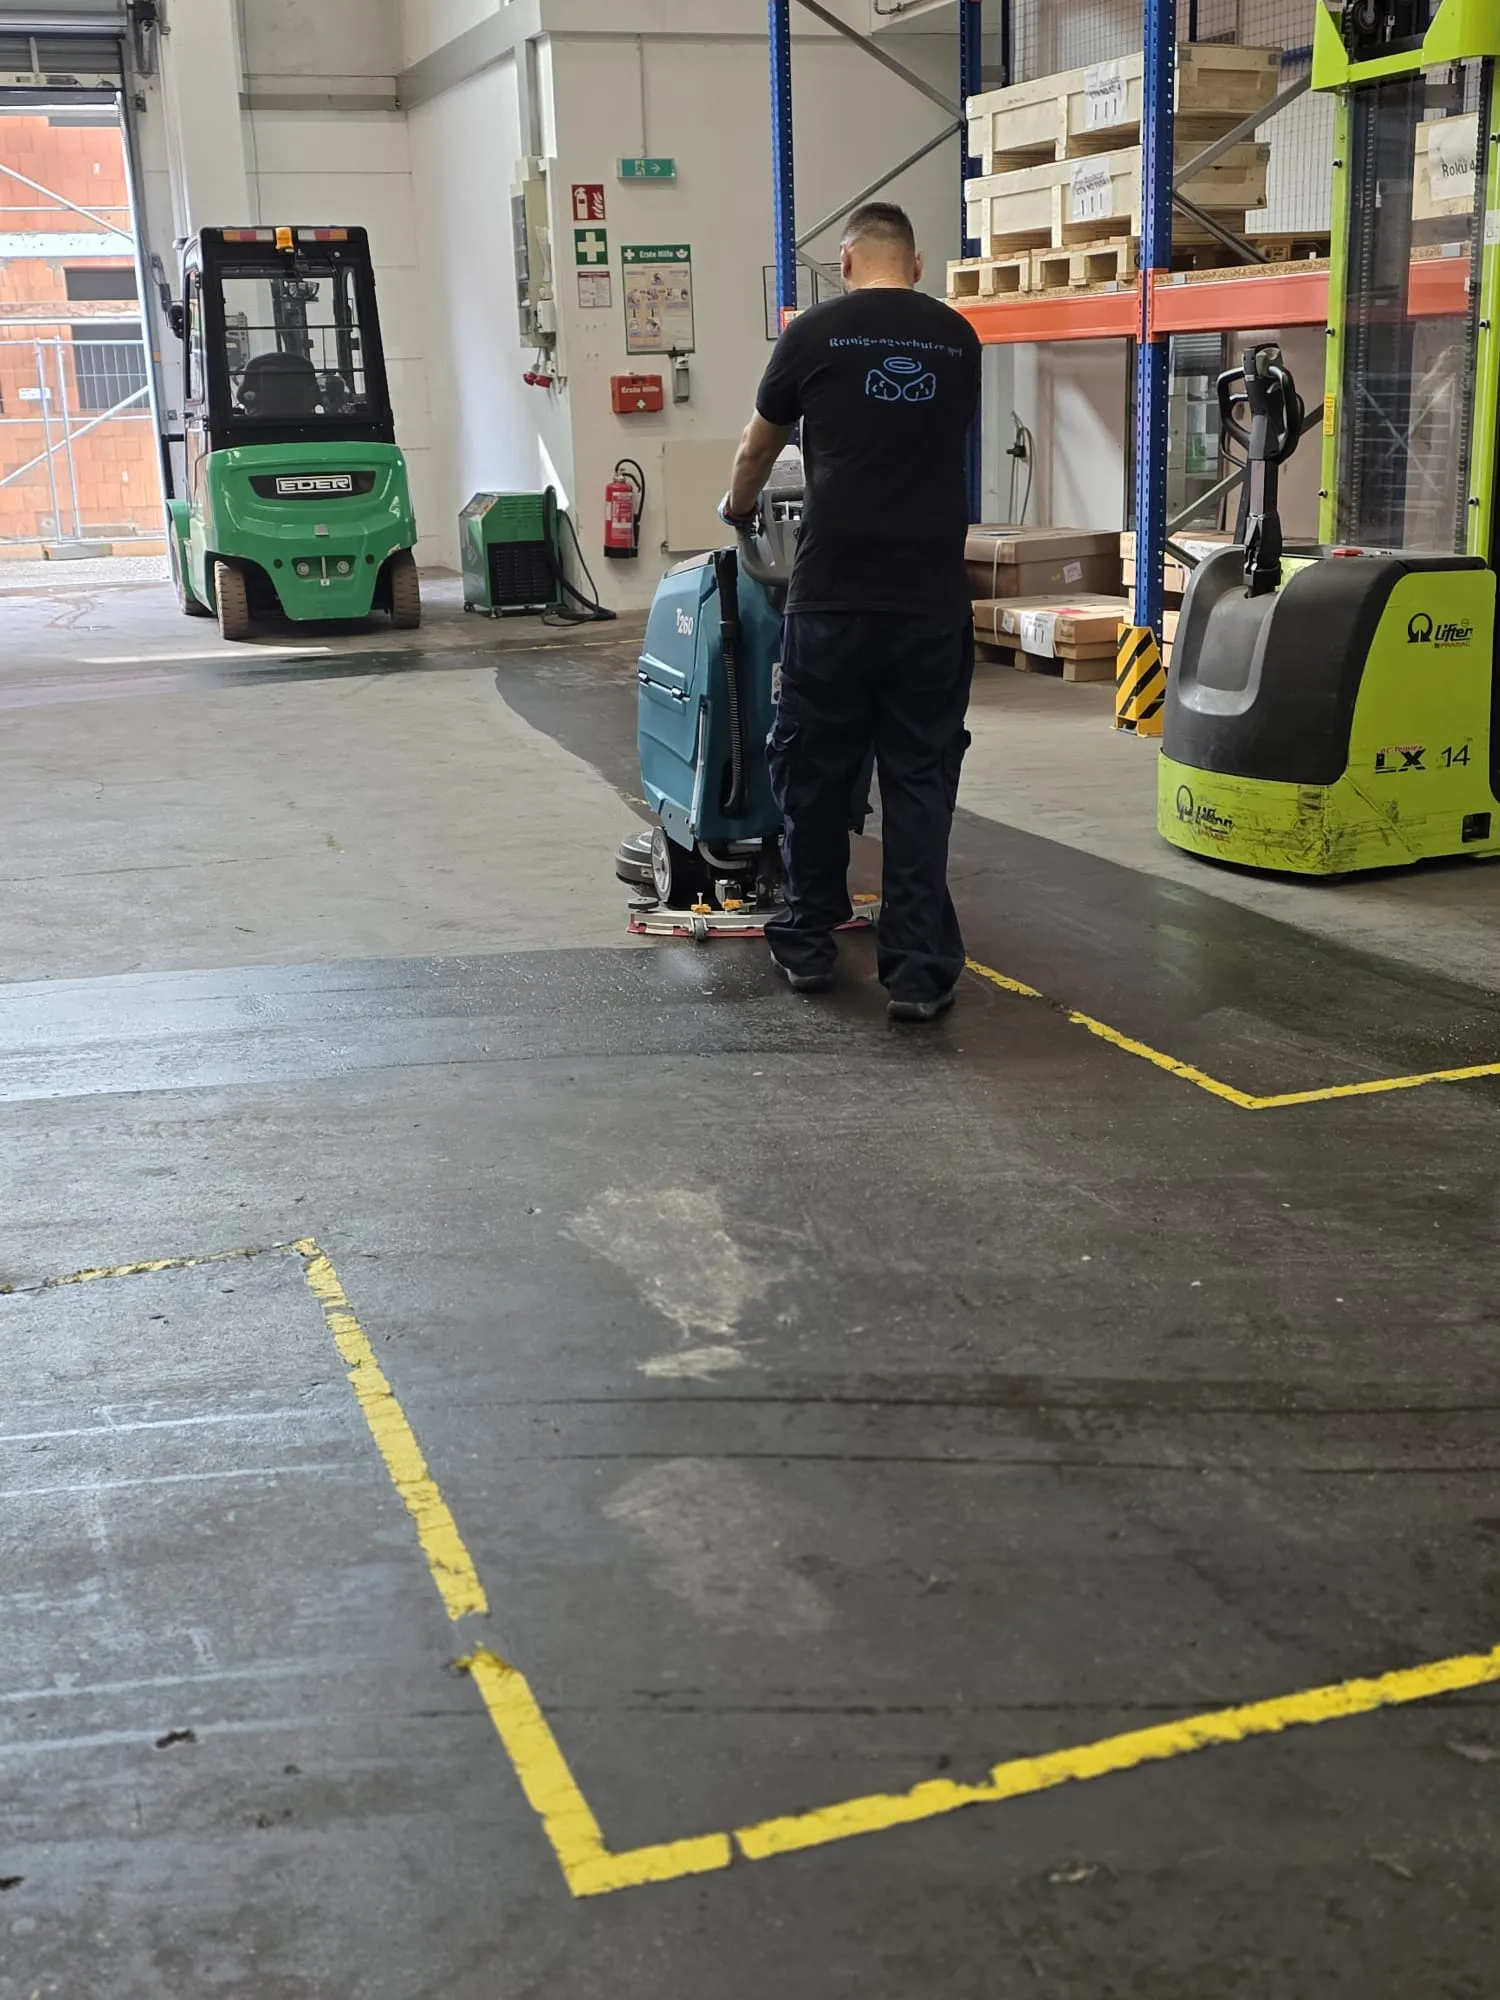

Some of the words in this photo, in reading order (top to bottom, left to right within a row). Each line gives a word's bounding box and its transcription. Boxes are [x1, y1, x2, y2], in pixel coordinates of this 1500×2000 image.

[1441, 161, 1467, 178] Roku
[639, 250, 657, 258] Erste
[621, 386, 641, 394] Erste
[279, 478, 349, 491] EDER
[1434, 624, 1473, 642] Lifter
[1375, 749, 1426, 774] LX
[1441, 744, 1471, 767] 14
